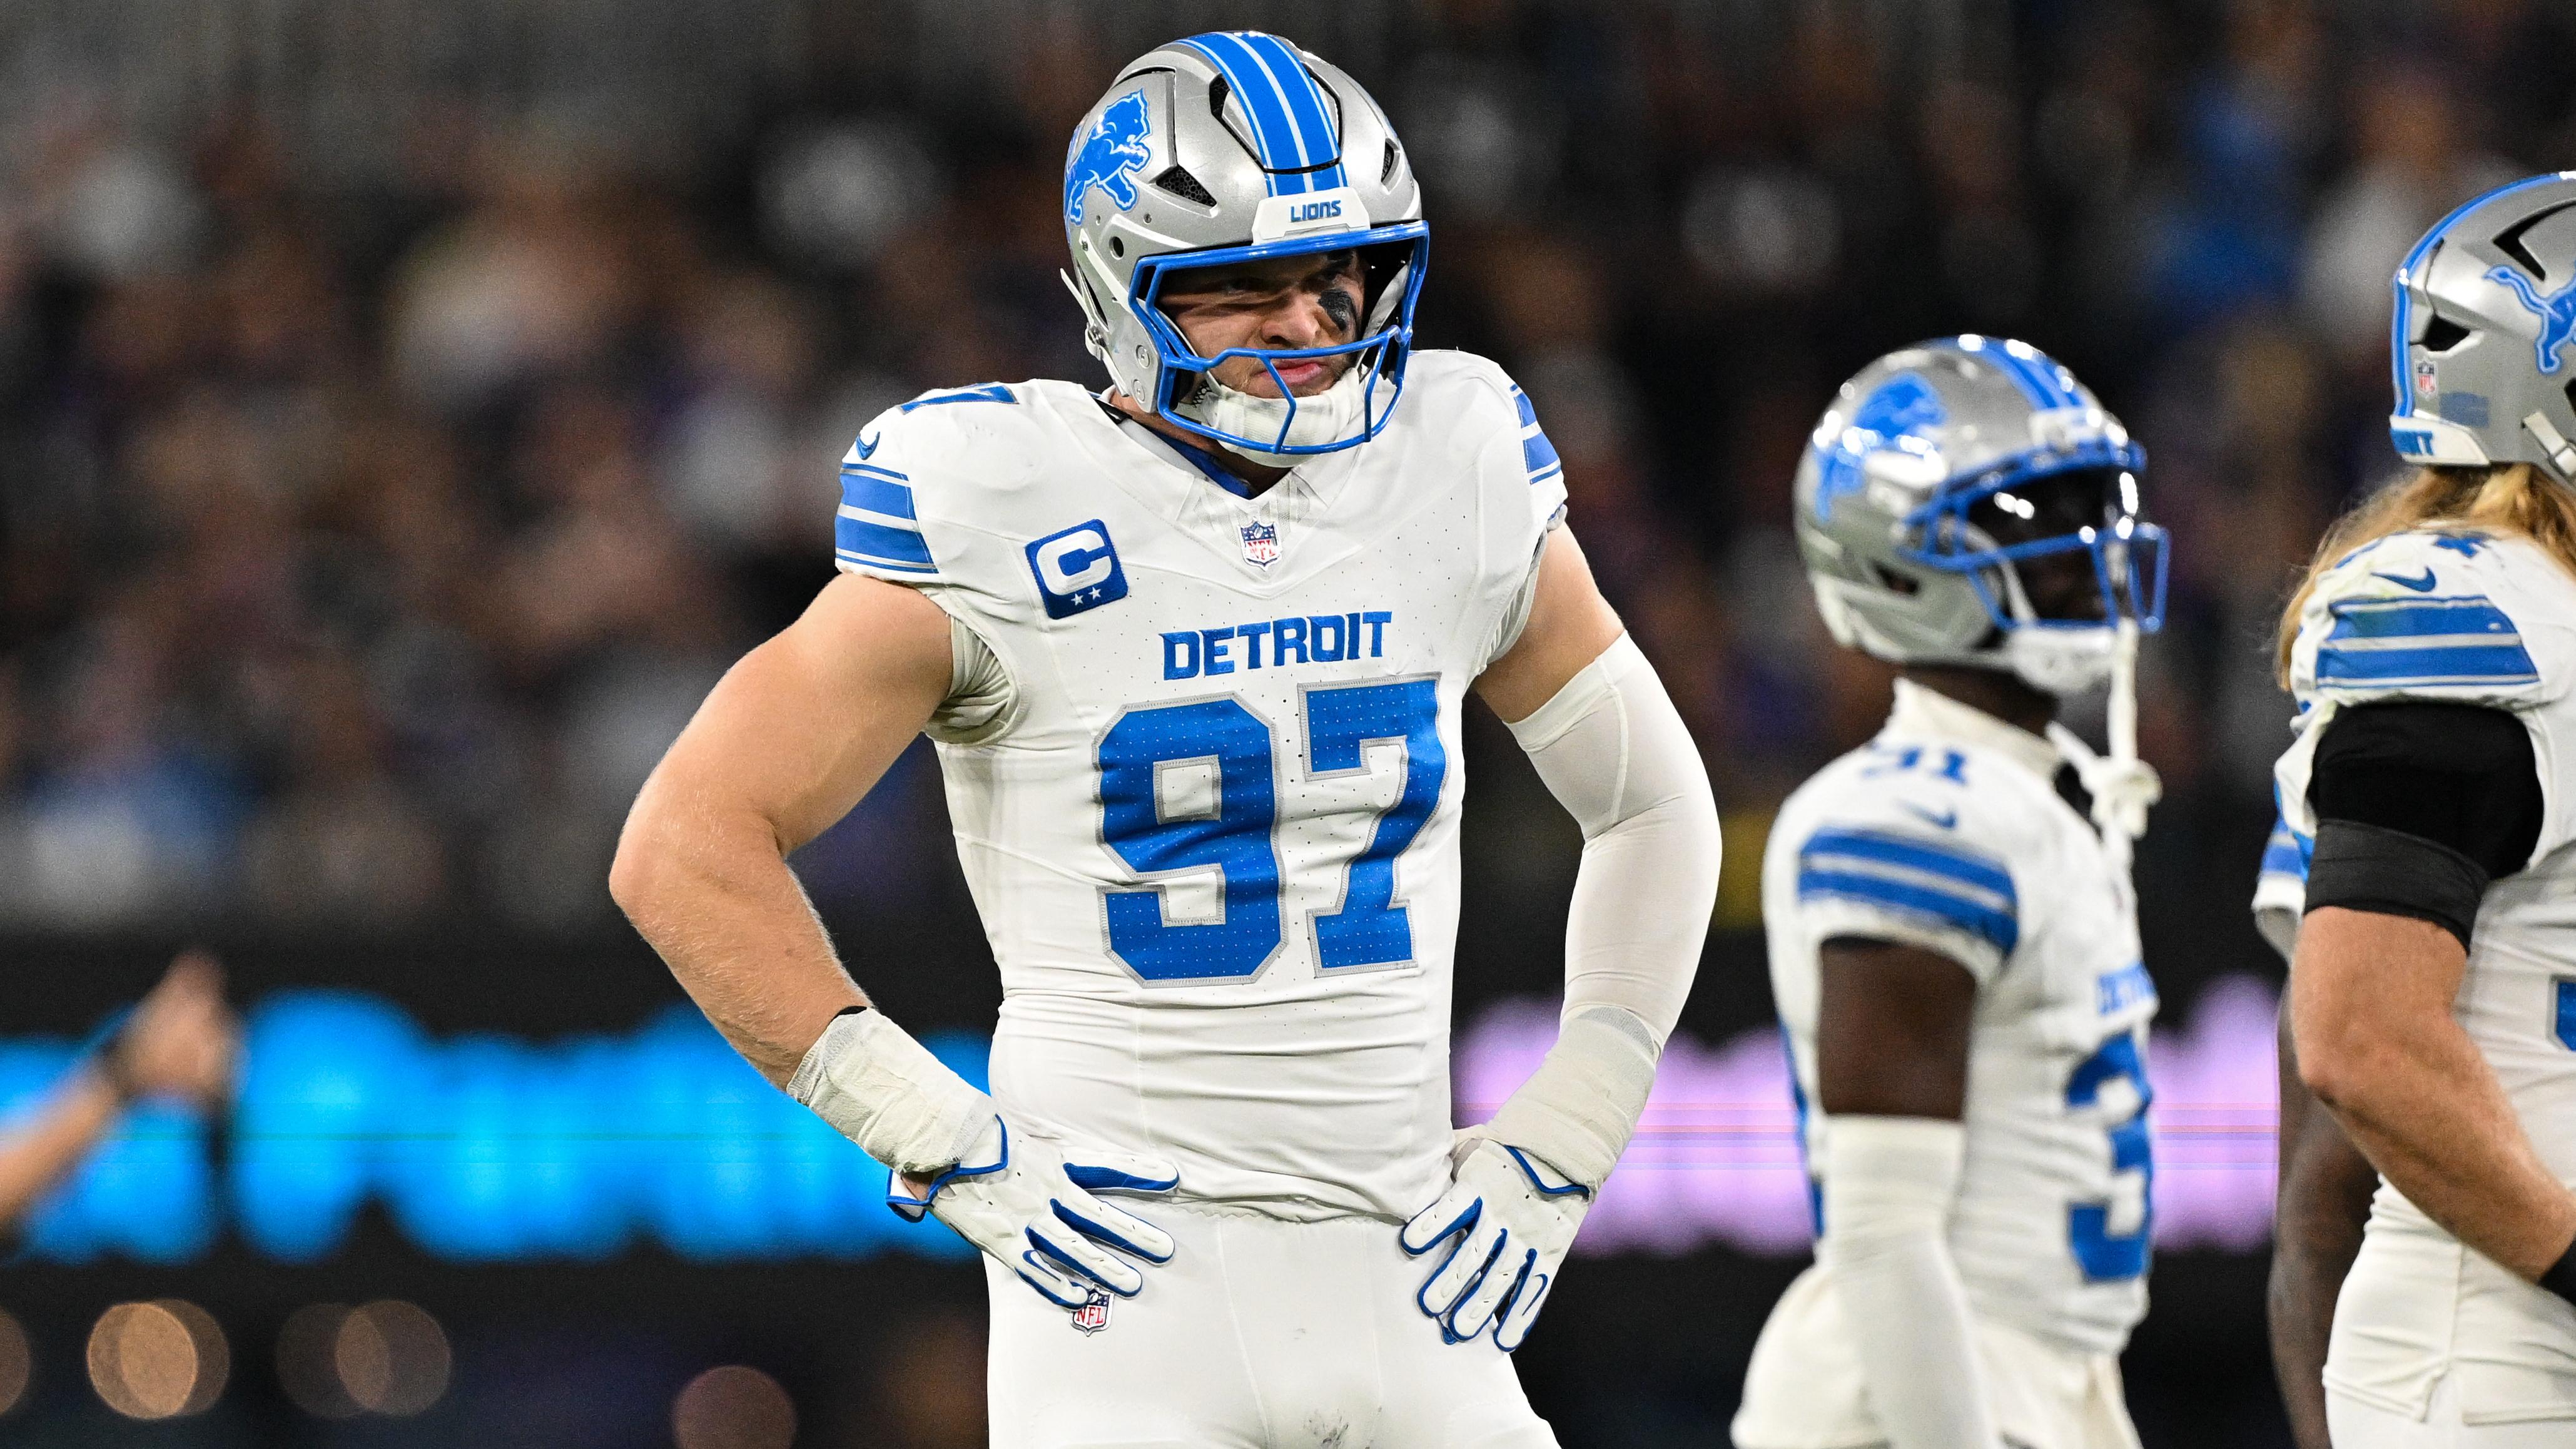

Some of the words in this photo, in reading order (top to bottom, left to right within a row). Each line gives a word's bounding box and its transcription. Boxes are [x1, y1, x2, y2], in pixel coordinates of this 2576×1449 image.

[1290, 200, 1342, 223] LIONS
[1036, 529, 1112, 596] C
[1247, 540, 1276, 560] NFL
[1159, 611, 1393, 681] DETROIT
[1092, 671, 1453, 990] 97
[1075, 1306, 1104, 1326] NFL
